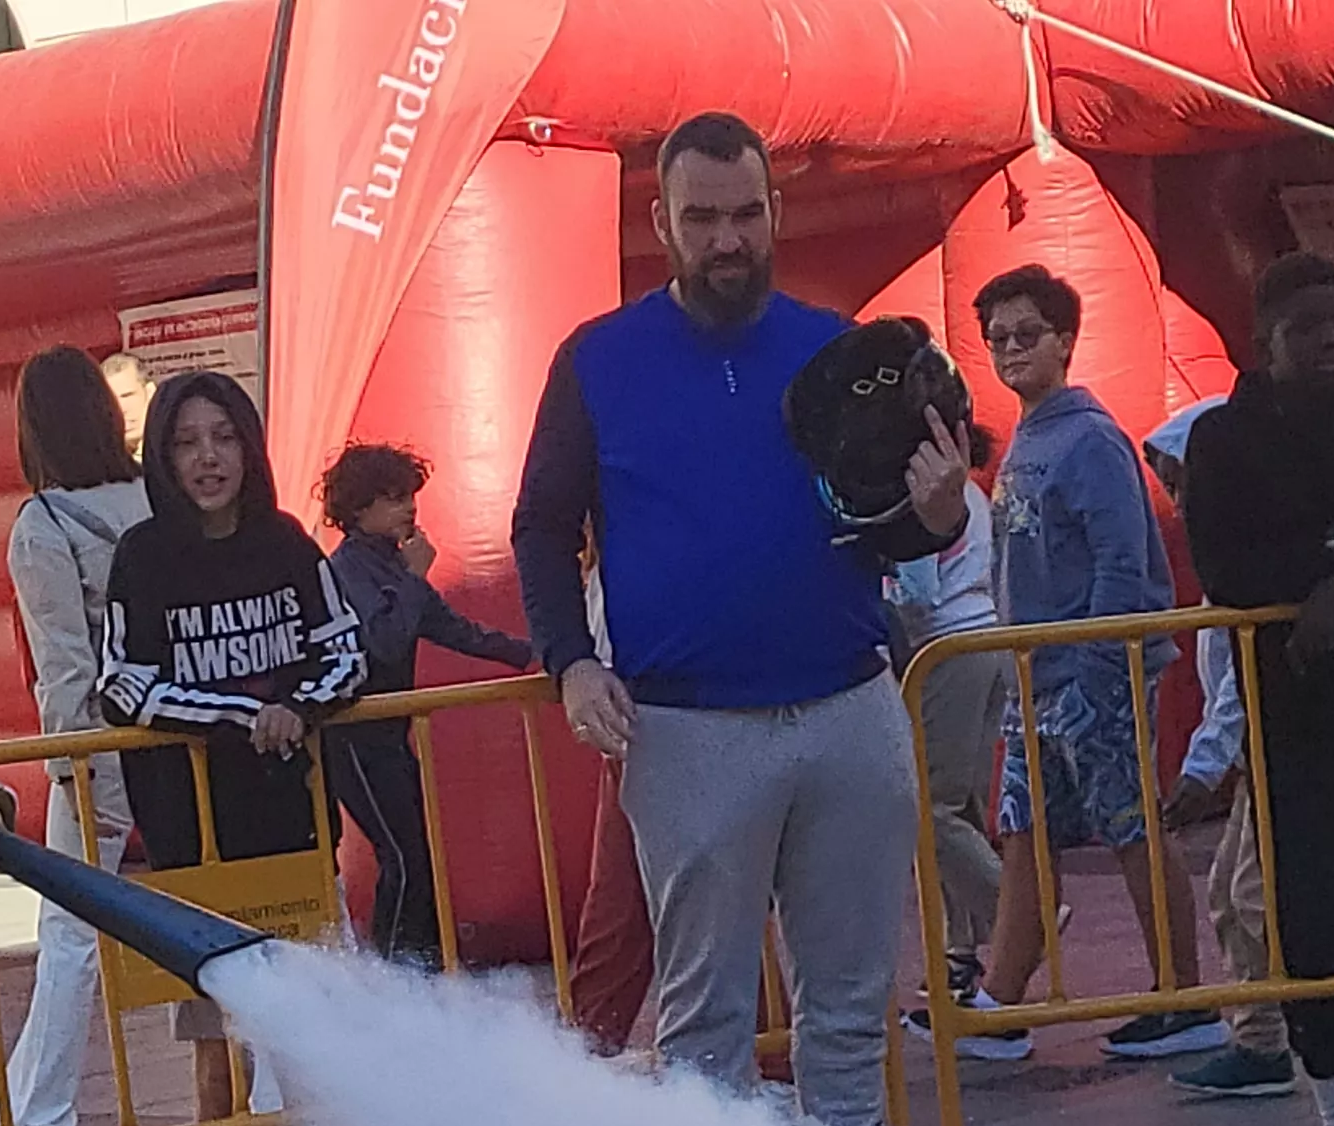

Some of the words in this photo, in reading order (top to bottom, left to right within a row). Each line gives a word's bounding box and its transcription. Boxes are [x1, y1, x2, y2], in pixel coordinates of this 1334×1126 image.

[165, 606, 204, 640] I'M
[211, 586, 300, 635] ALWAYS
[173, 619, 307, 684] AWSOME
